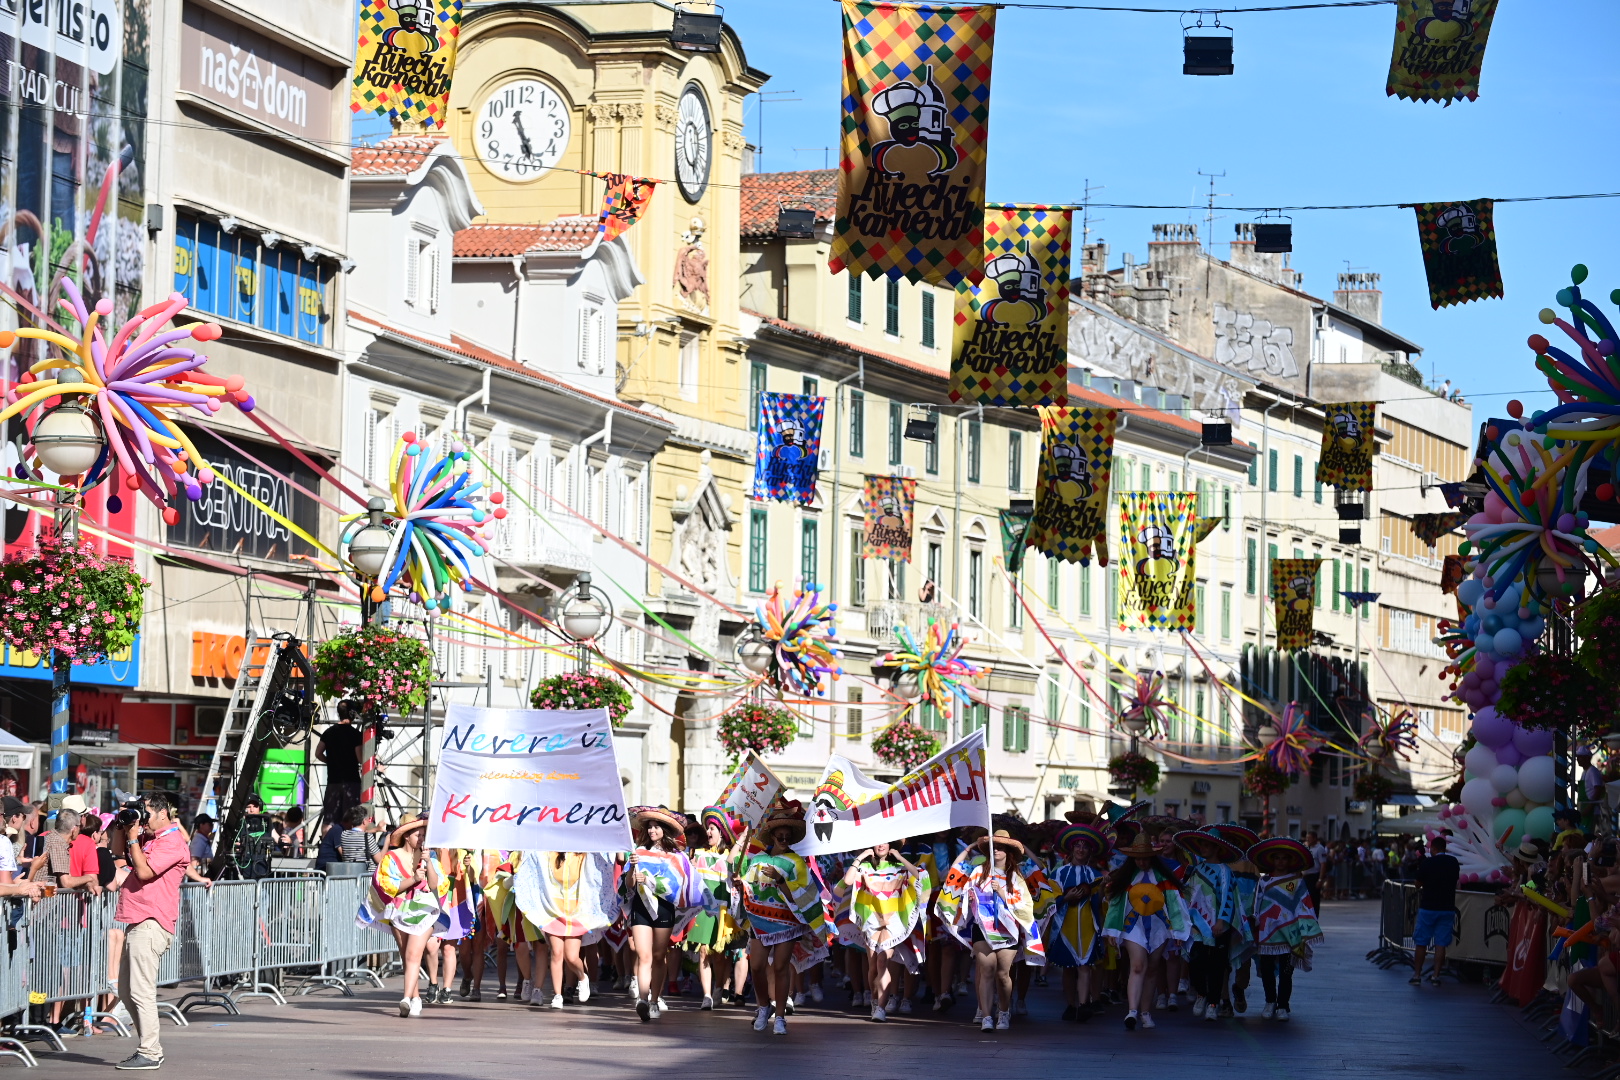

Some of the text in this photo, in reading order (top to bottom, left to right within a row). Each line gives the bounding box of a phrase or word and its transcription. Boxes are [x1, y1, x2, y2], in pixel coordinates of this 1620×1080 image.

[361, 59, 448, 97] karneval
[6, 59, 89, 119] TRADCIJU
[263, 63, 307, 127] dom
[519, 86, 534, 104] 12
[488, 99, 504, 118] 10
[503, 90, 514, 109] 11
[540, 90, 545, 109] 1
[548, 100, 557, 118] 2
[481, 121, 493, 139] 9
[553, 119, 564, 138] 3
[488, 140, 500, 159] 8
[545, 138, 557, 156] 4
[503, 153, 514, 171] 7
[516, 156, 528, 175] 6
[847, 194, 975, 240] karneval
[959, 340, 1060, 374] karneval
[442, 723, 609, 754] Nevera iz
[753, 773, 769, 792] 2
[442, 794, 625, 826] Kvarnera
